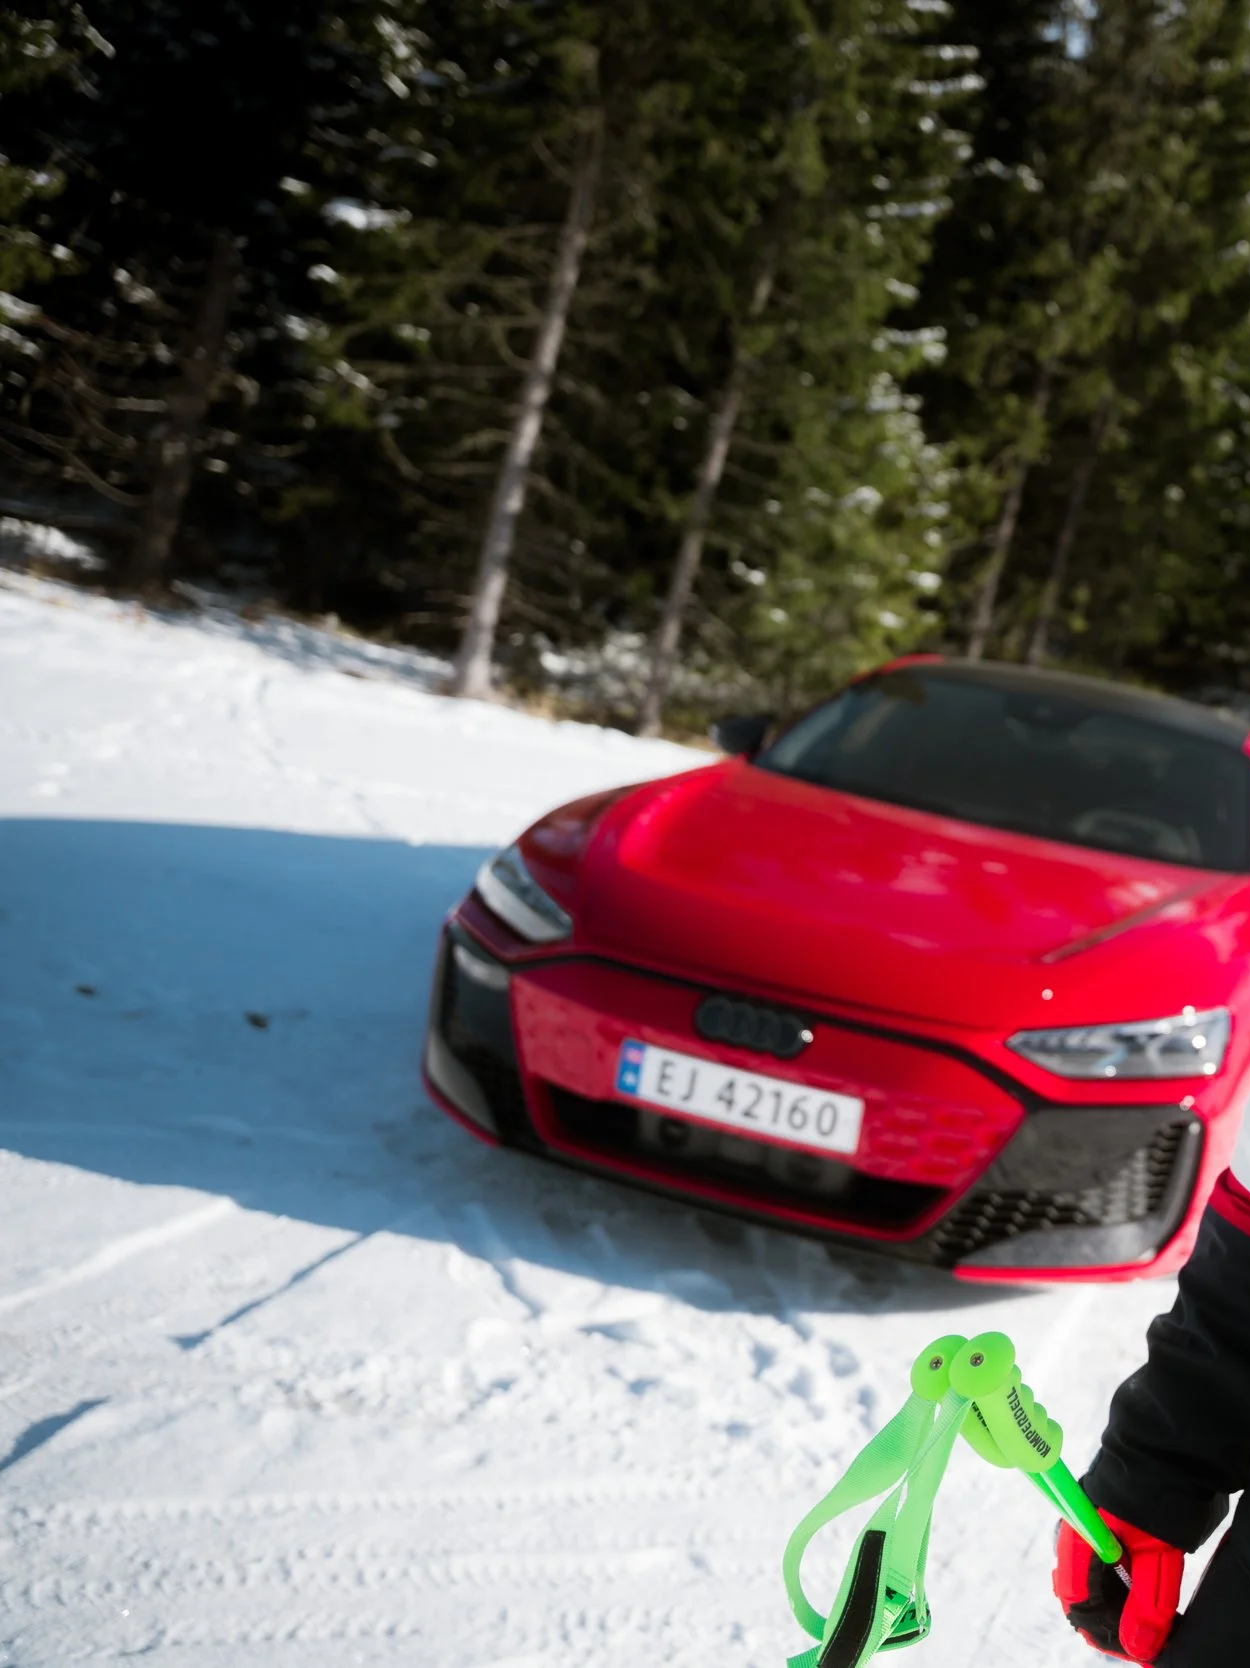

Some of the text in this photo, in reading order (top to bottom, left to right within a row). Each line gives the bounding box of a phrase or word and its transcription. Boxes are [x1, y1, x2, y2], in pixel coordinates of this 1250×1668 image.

[655, 1060, 839, 1137] EJ 42160
[1007, 1386, 1051, 1458] KOMPERDELL
